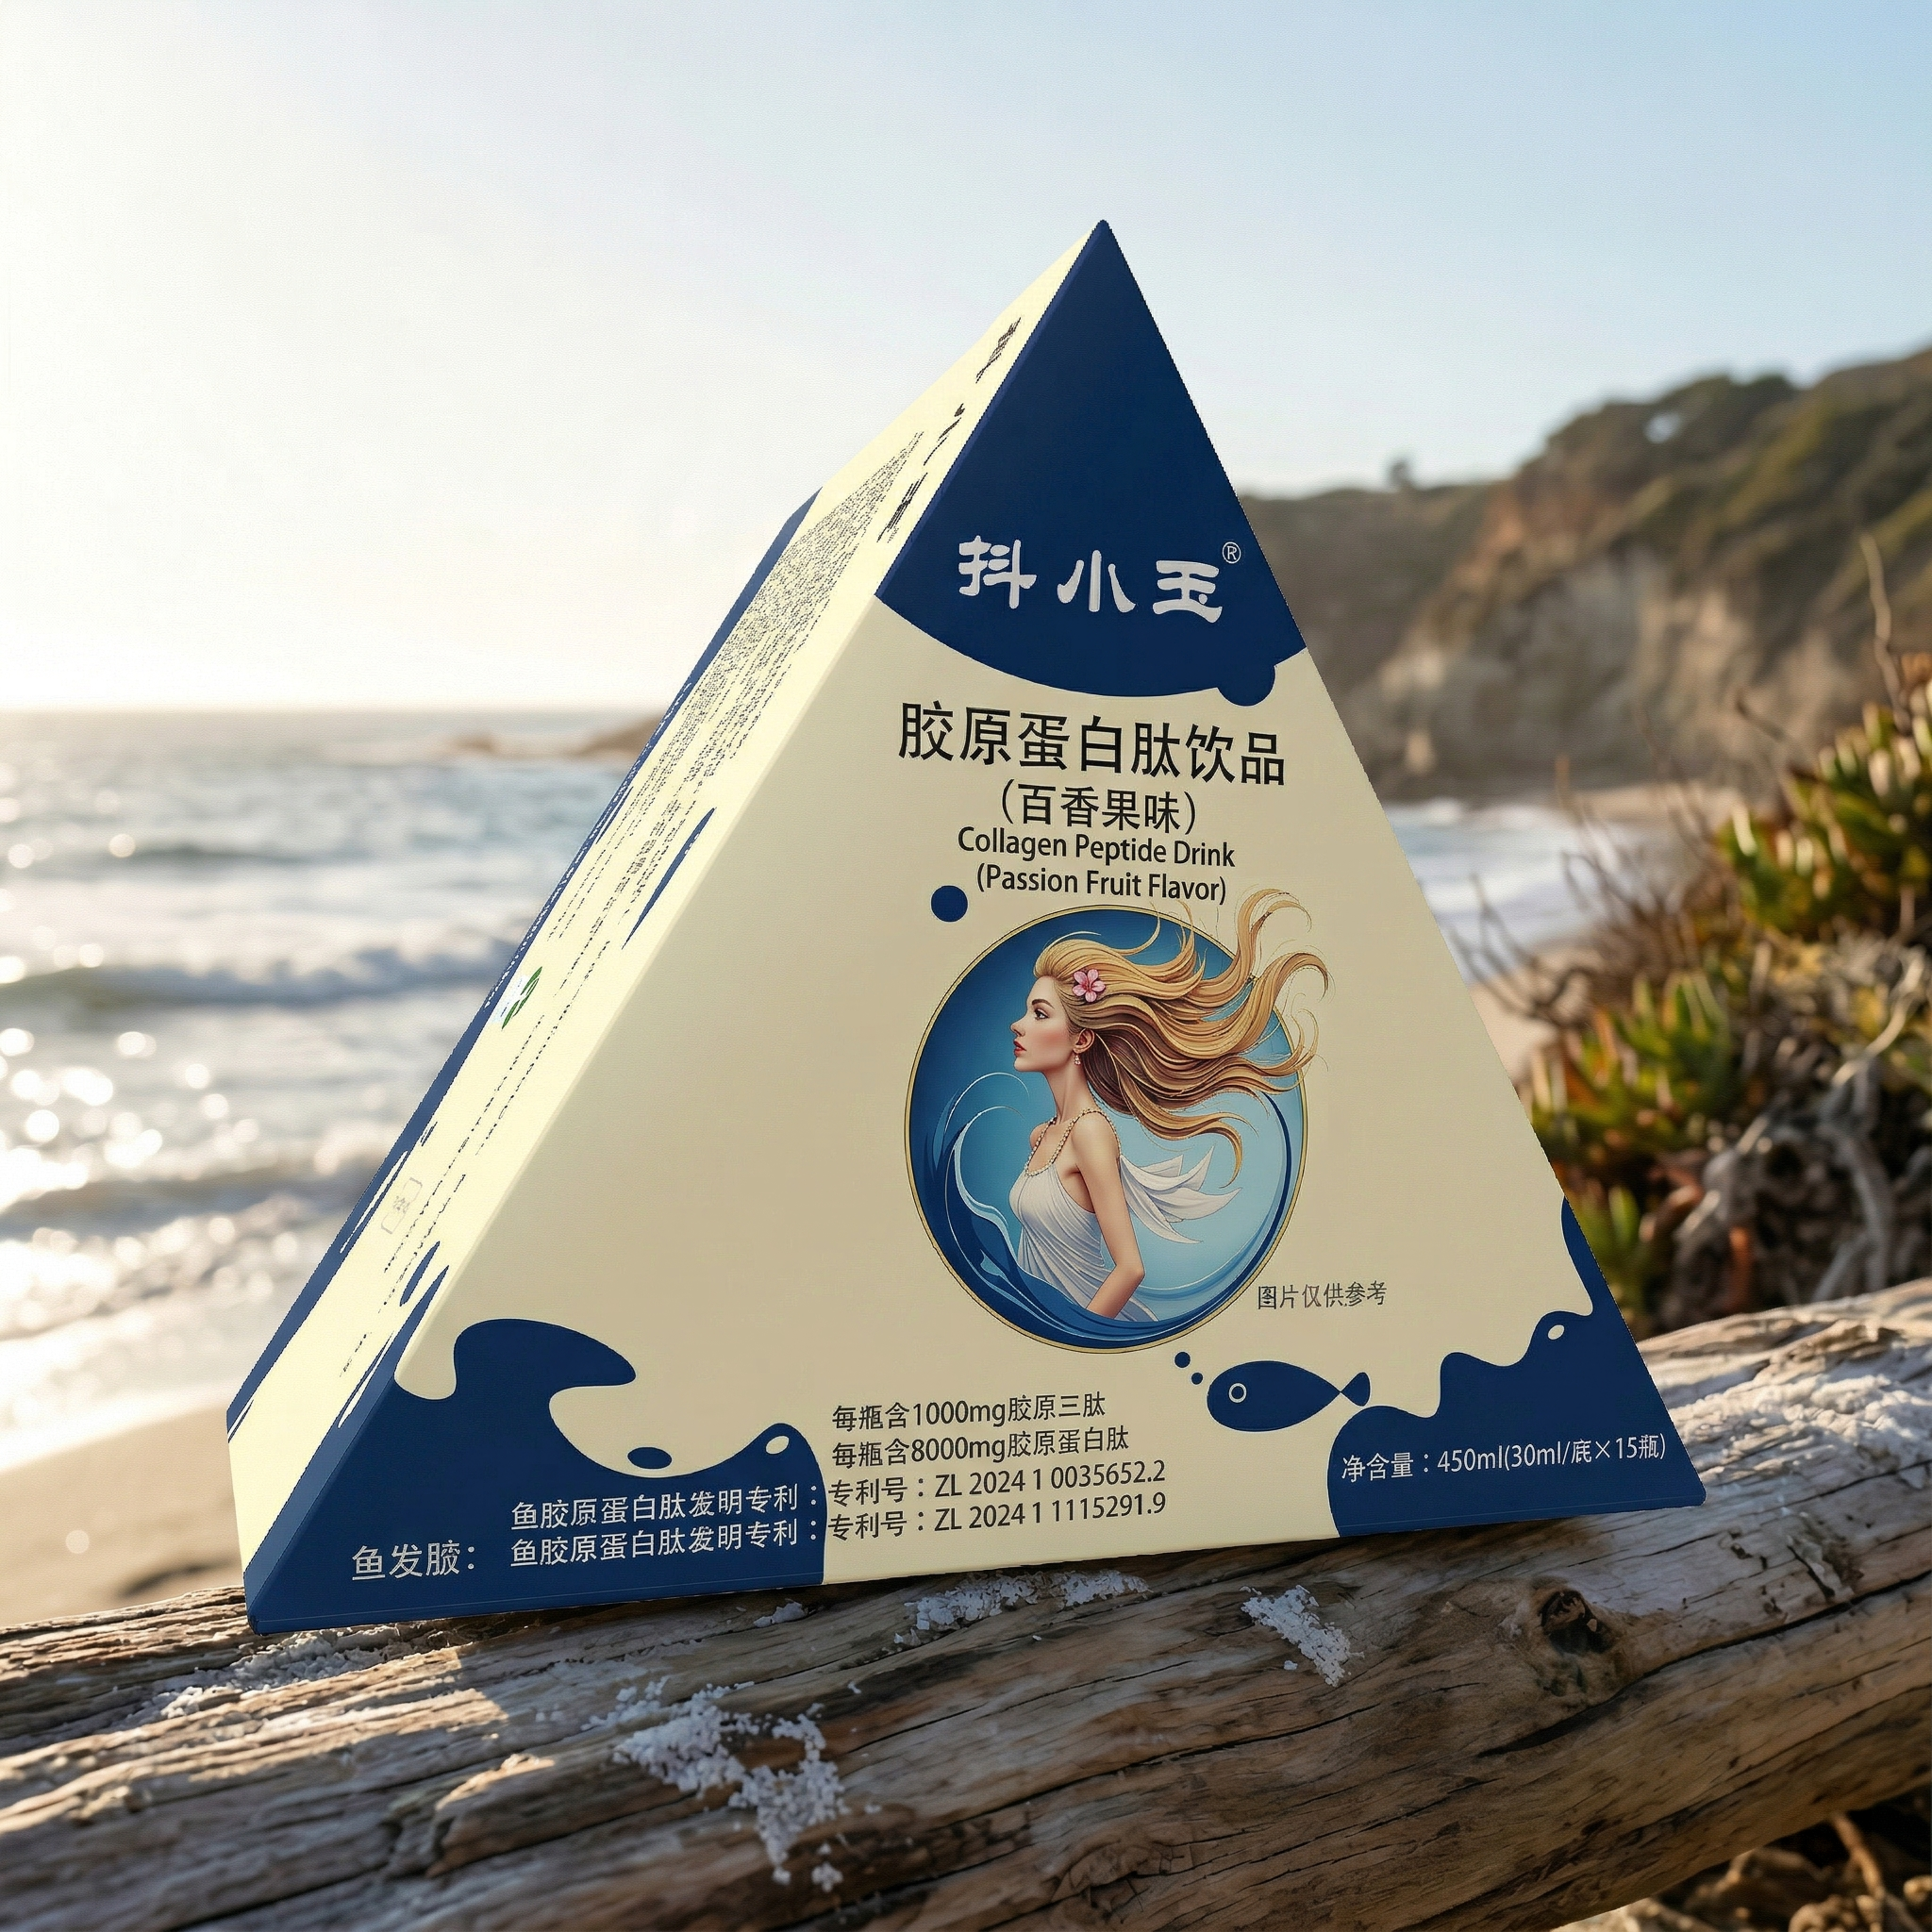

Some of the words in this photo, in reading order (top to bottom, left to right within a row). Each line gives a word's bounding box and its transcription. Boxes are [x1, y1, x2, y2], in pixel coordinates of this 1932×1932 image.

[958, 535, 1223, 623] 抖小玉
[899, 700, 1284, 785] 胶原蛋白肽饮品
[958, 826, 1066, 862] Collagen
[1076, 833, 1166, 864] Peptide
[1174, 840, 1235, 867] Drink
[977, 863, 1078, 893] (Passion
[1087, 870, 1141, 897] Fruit
[1149, 873, 1226, 905] Flavor)
[1258, 1280, 1387, 1310] 图片仅供参考
[969, 1469, 1026, 1496] 2024
[1051, 1460, 1165, 1489] 0035652.2
[969, 1503, 1025, 1529] 2024
[1052, 1492, 1166, 1522] 1115291.9
